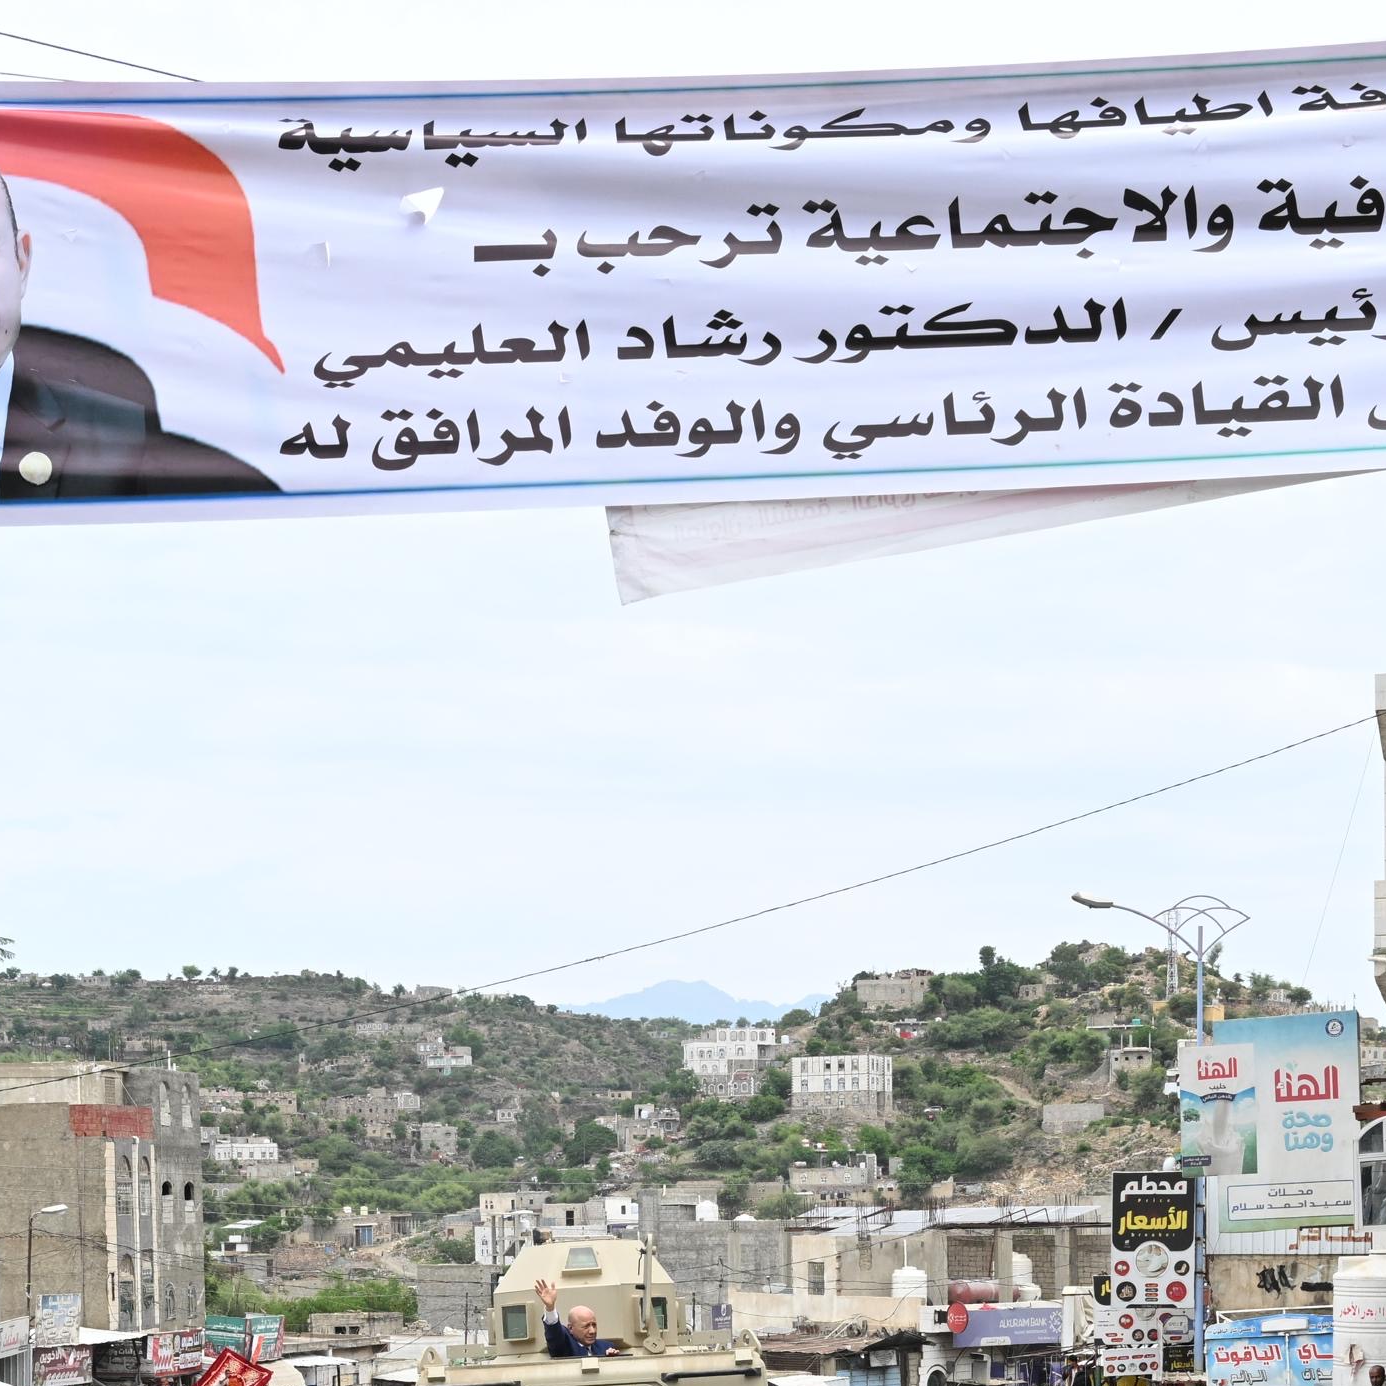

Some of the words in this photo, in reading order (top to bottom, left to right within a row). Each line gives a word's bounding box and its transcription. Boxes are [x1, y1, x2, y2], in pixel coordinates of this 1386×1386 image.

[612, 105, 992, 158] ومكوناتها
[1016, 89, 1275, 140] اطيافها
[276, 112, 588, 173] السياسية
[576, 202, 783, 275] ترحب
[801, 180, 1236, 266] والاجتماعية
[616, 308, 782, 366] رشاد
[795, 296, 1128, 364] الدكتور
[1150, 308, 1183, 341] /
[313, 319, 591, 389] العليمي
[822, 386, 1101, 460] الرئاسي
[1107, 374, 1345, 429] القيادة
[279, 414, 351, 460] له
[371, 405, 572, 471] المرافق
[596, 398, 801, 458] والوفد
[1209, 1082, 1227, 1091] حليب
[1282, 1109, 1332, 1130] صحة
[1119, 1175, 1188, 1203] محطم
[1231, 1203, 1265, 1214] سلام
[1266, 1200, 1308, 1210] احمد
[1268, 1187, 1314, 1197] محلات
[1309, 1198, 1352, 1211] سعيد
[1117, 1207, 1189, 1238] الأسعار
[1214, 1343, 1282, 1368] الياقوت
